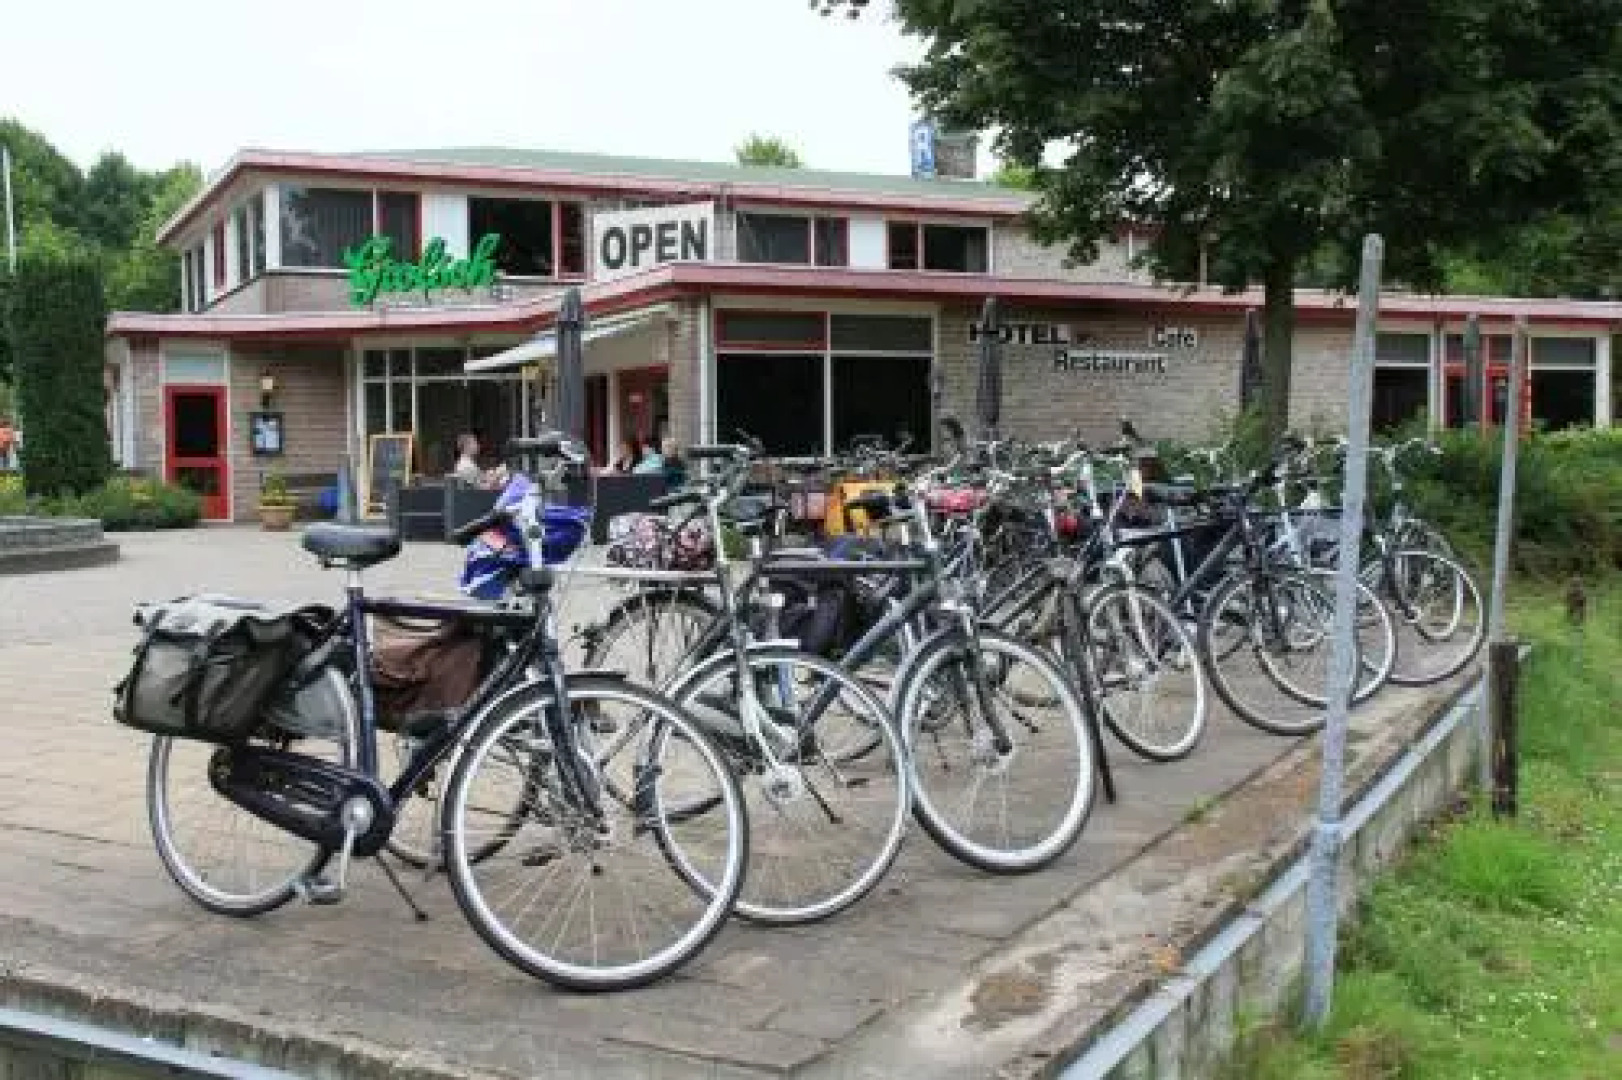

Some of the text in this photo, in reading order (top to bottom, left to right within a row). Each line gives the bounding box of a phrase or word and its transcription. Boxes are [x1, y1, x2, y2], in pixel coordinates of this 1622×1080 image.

[602, 217, 707, 269] OPEN
[968, 322, 1068, 345] HOTEL
[1053, 349, 1167, 373] Restaurant
